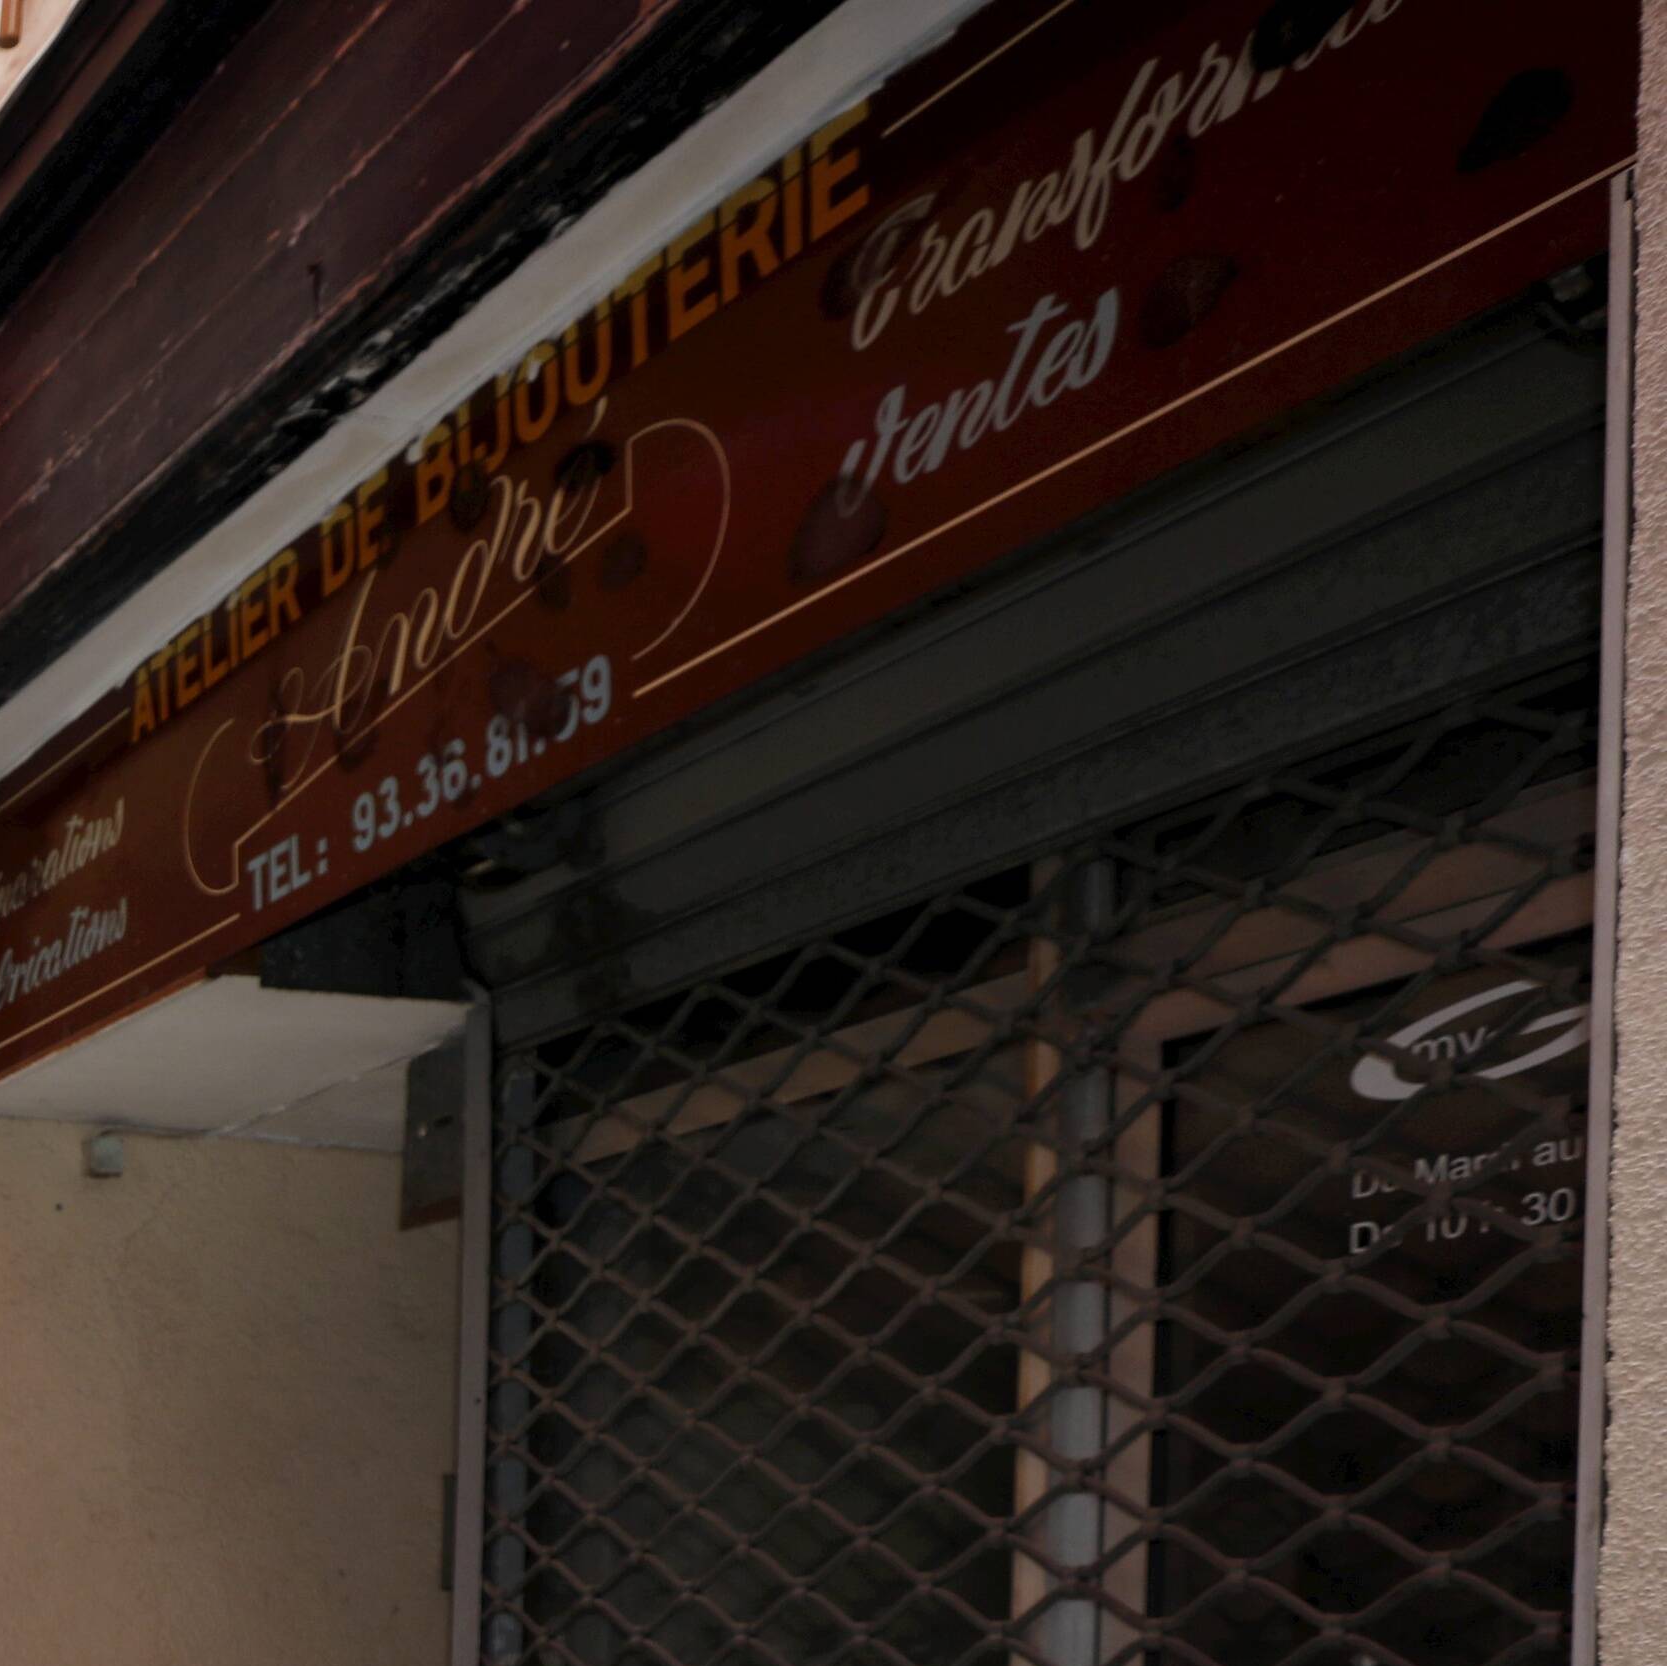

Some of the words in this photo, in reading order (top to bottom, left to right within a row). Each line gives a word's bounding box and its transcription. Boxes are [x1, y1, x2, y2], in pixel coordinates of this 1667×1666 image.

[131, 550, 303, 744] ATELIER
[319, 469, 392, 594] DE
[415, 104, 870, 525] BIJOUTERIE
[251, 396, 608, 792] André
[1414, 1140, 1522, 1184] Mar
[1520, 1186, 1576, 1227] 30
